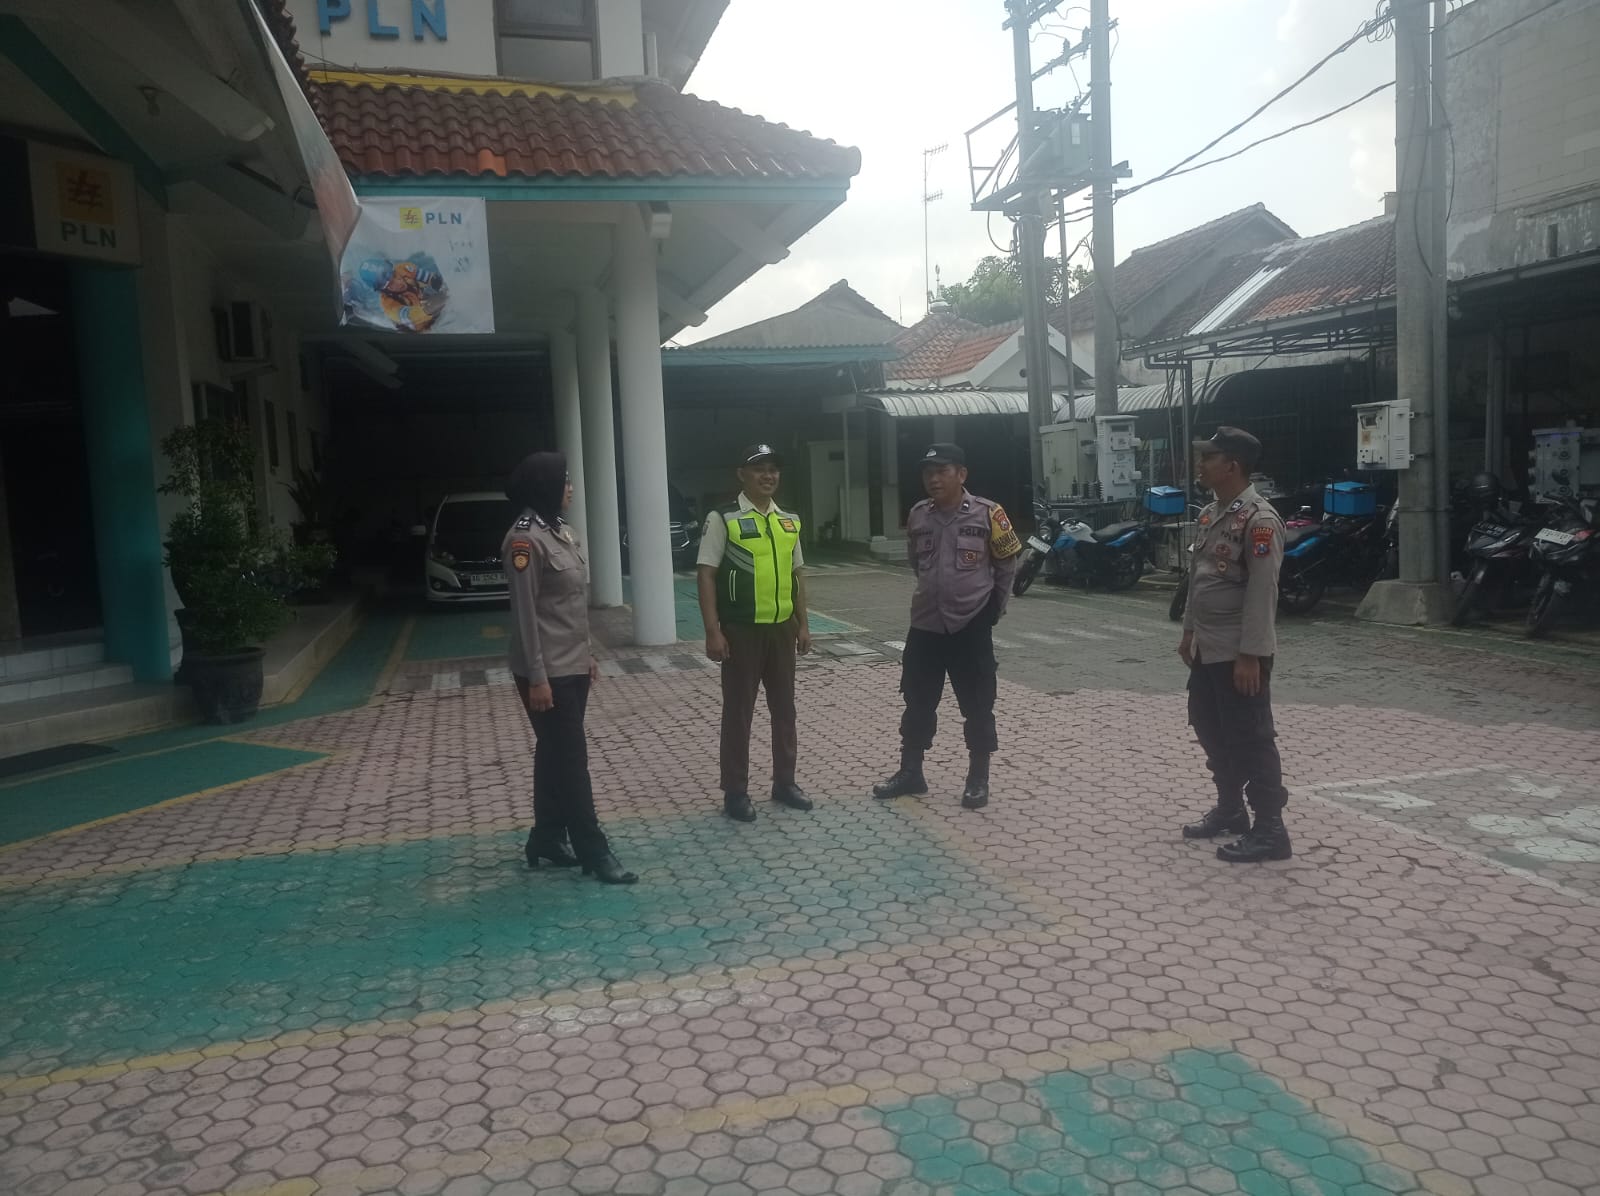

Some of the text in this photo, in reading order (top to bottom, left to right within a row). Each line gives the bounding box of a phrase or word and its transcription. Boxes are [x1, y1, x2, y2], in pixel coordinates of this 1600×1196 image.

[317, 0, 447, 41] PLN
[425, 212, 462, 225] PLN
[61, 221, 116, 248] PLN
